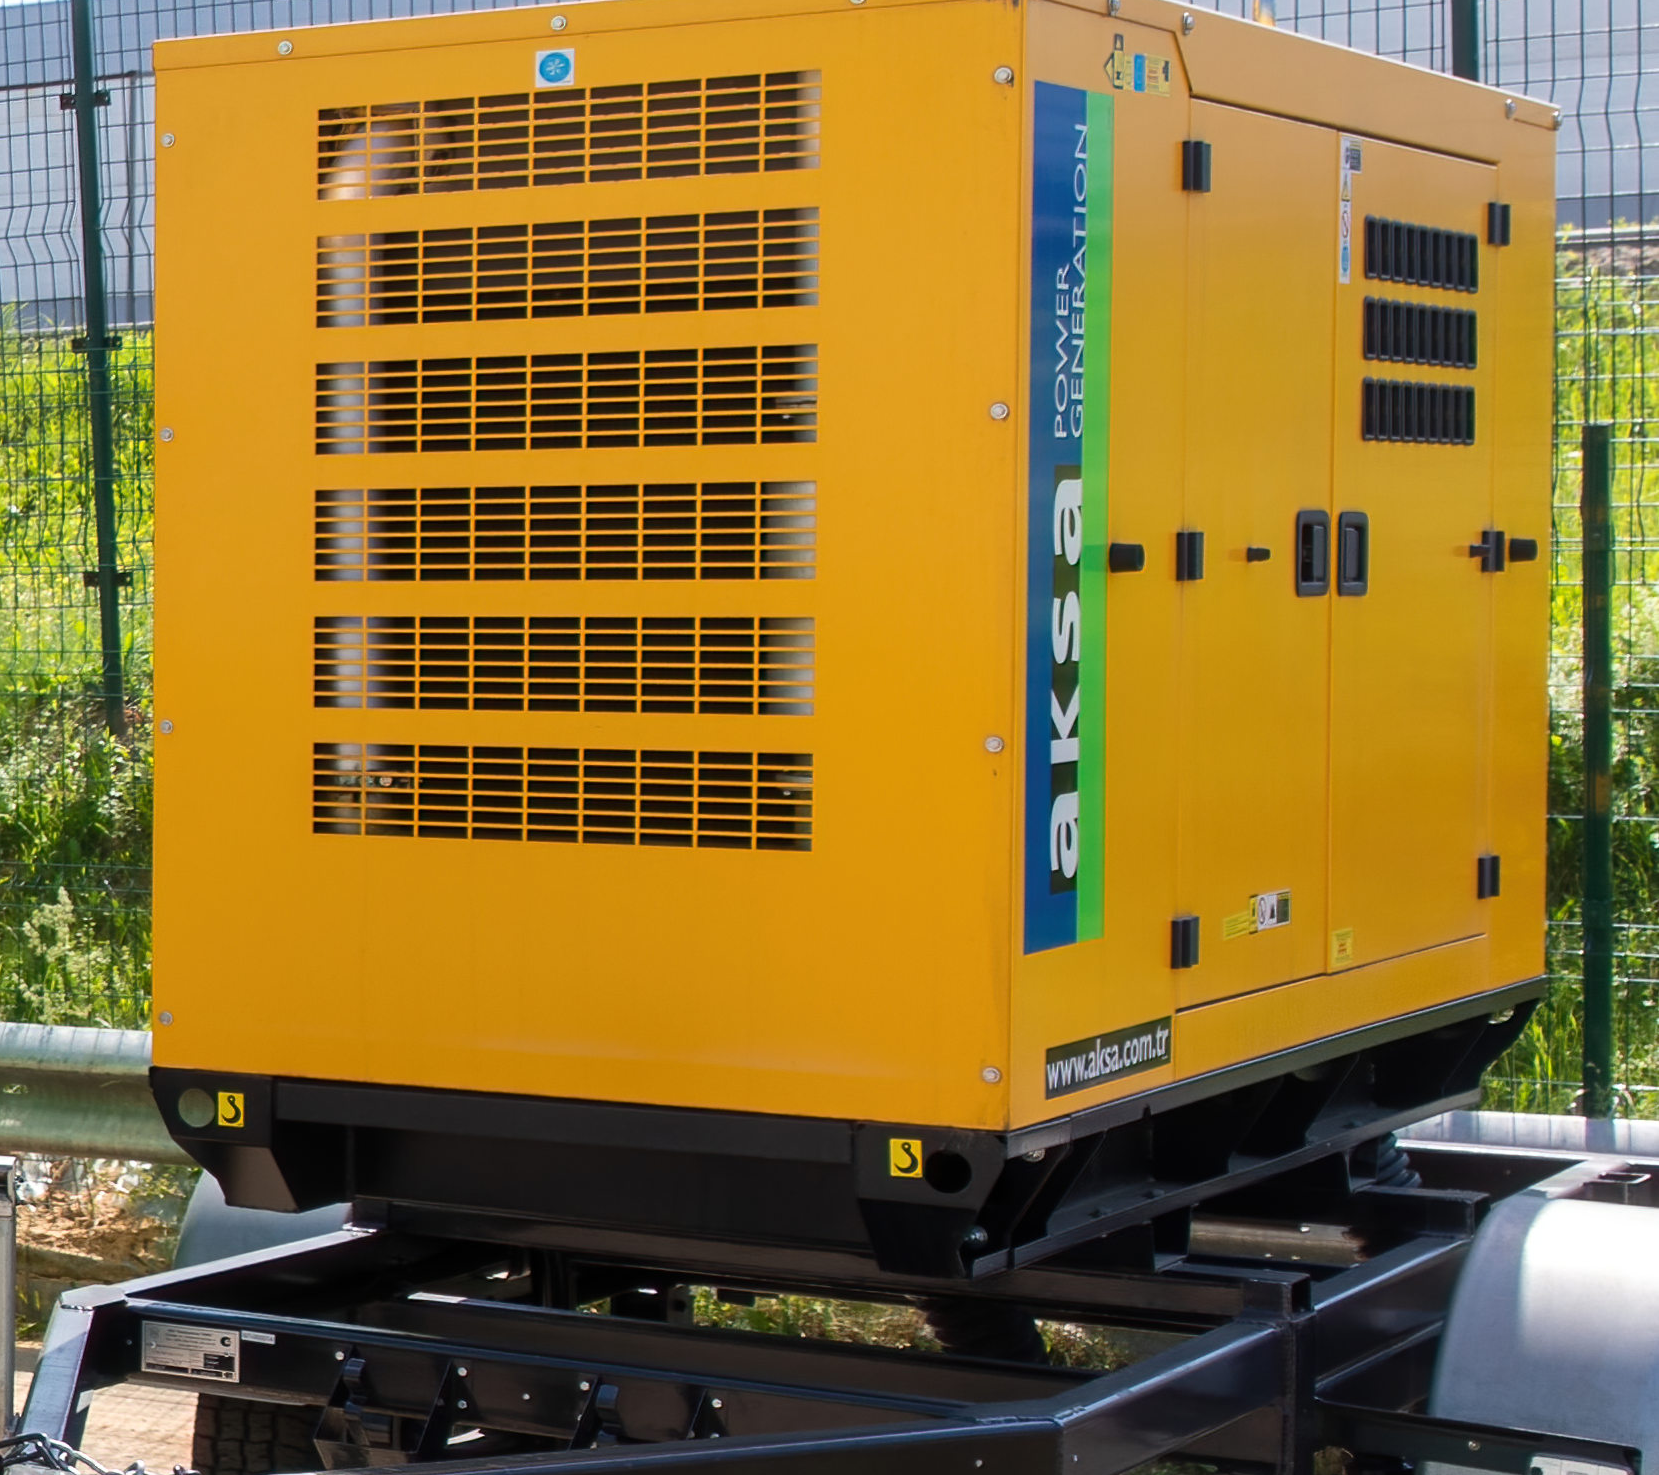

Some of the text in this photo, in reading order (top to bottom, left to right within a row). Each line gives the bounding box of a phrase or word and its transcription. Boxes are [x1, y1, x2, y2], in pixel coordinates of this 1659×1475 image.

[1054, 262, 1069, 439] POWER
[1049, 477, 1084, 881] aksa
[1047, 1025, 1170, 1091] www.aksa.com.tr
